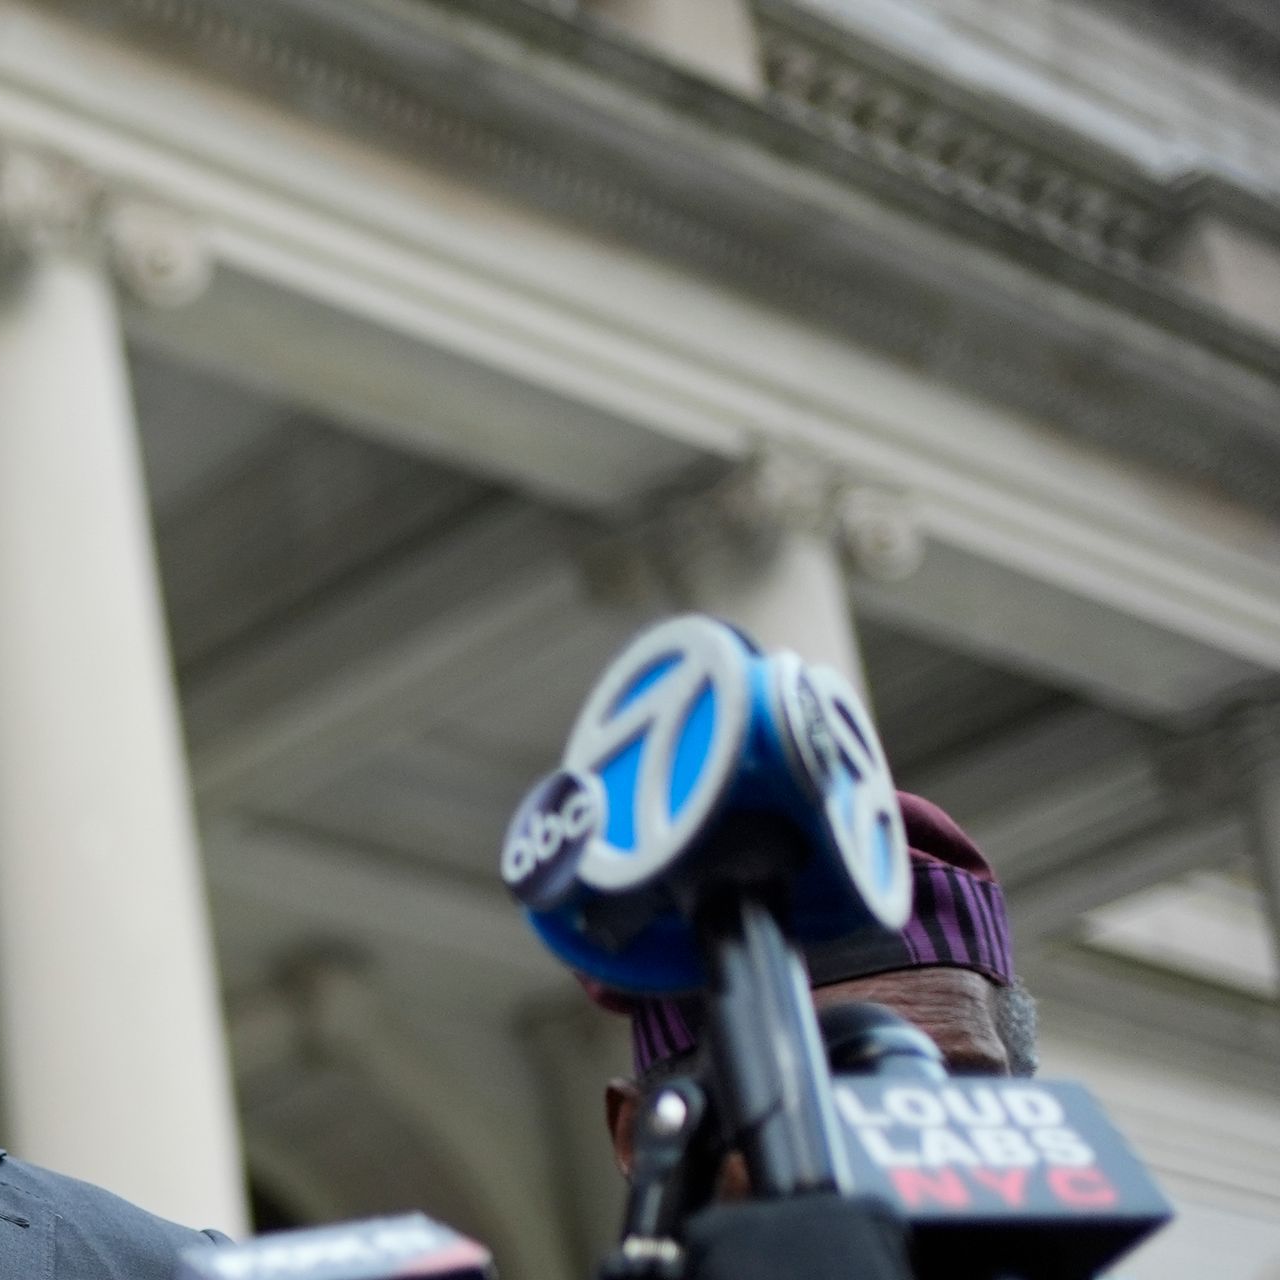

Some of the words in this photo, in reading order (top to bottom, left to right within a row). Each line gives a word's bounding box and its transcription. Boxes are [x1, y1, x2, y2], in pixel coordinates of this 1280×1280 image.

[832, 1085, 1066, 1128] LOUD
[854, 1125, 1097, 1170] LABS
[888, 1164, 1120, 1212] NYC
